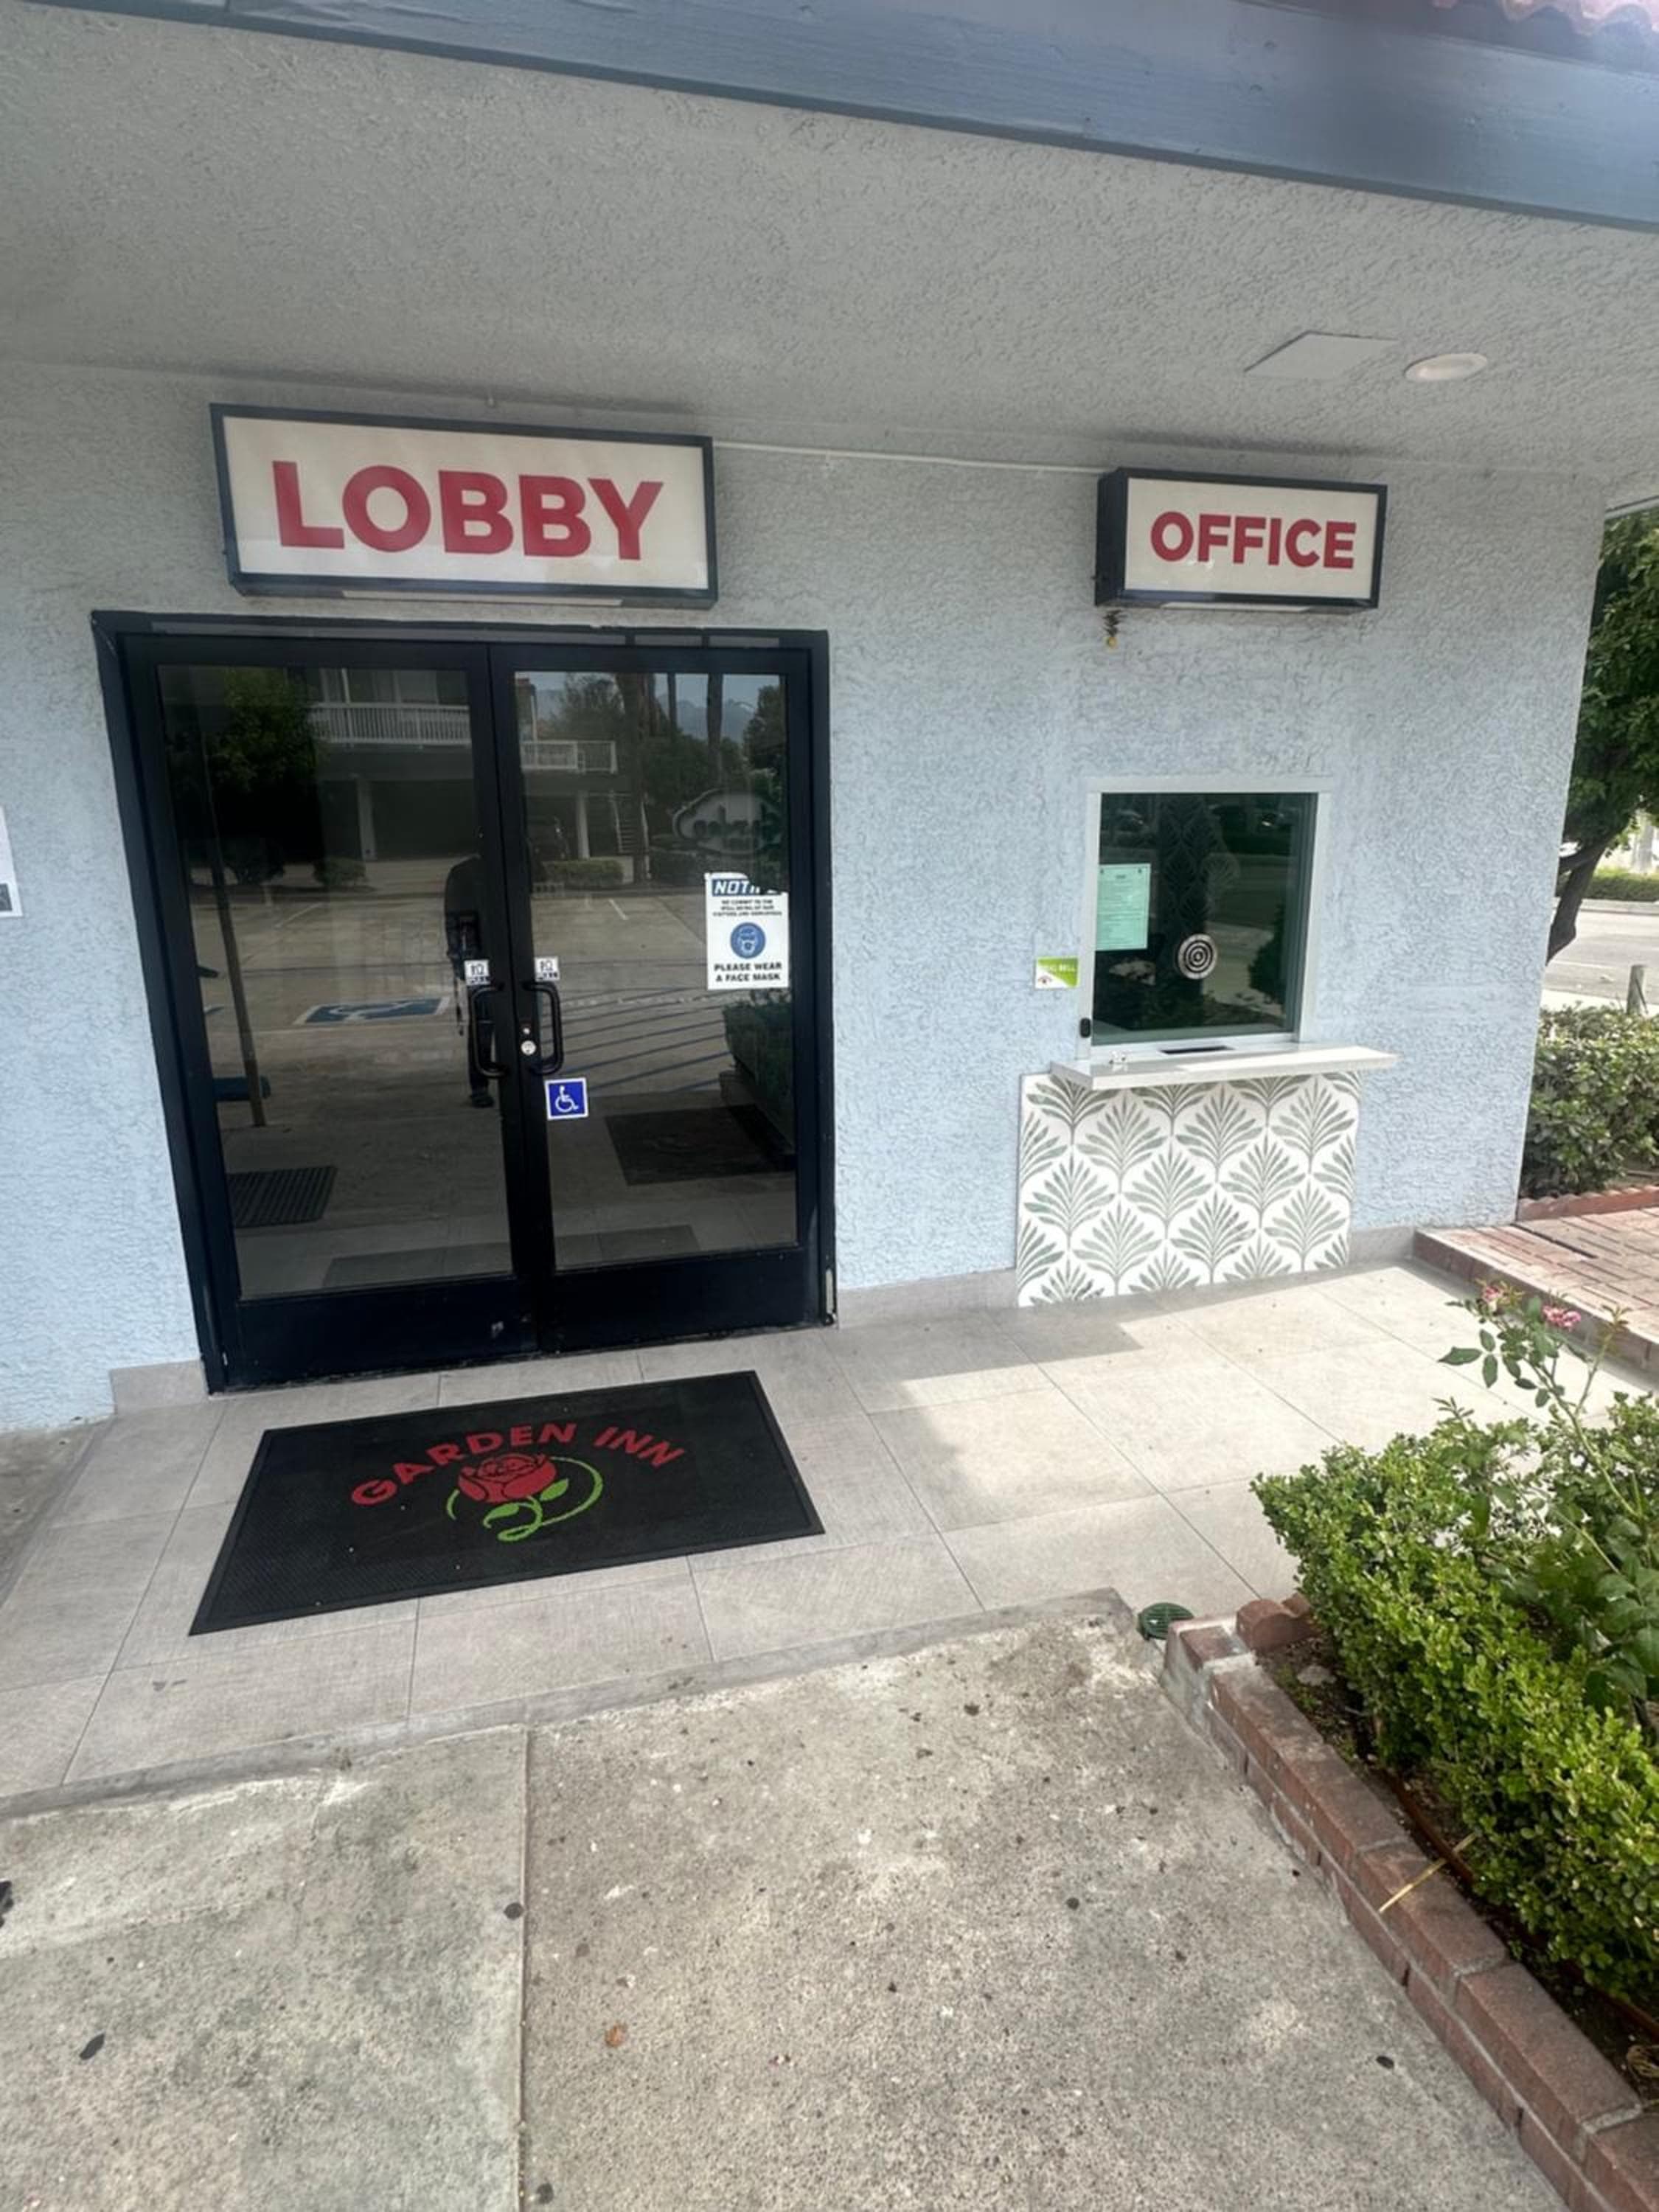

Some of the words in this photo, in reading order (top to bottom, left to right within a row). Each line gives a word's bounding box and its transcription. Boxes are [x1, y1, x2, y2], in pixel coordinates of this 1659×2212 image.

[272, 460, 664, 560] LOBBY
[1150, 511, 1356, 569] OFFICE
[714, 963, 751, 972] PLEASE
[754, 961, 782, 970] WEAR
[725, 973, 749, 982] FACE
[350, 1422, 577, 1506] GARDEN
[594, 1426, 685, 1468] INN
